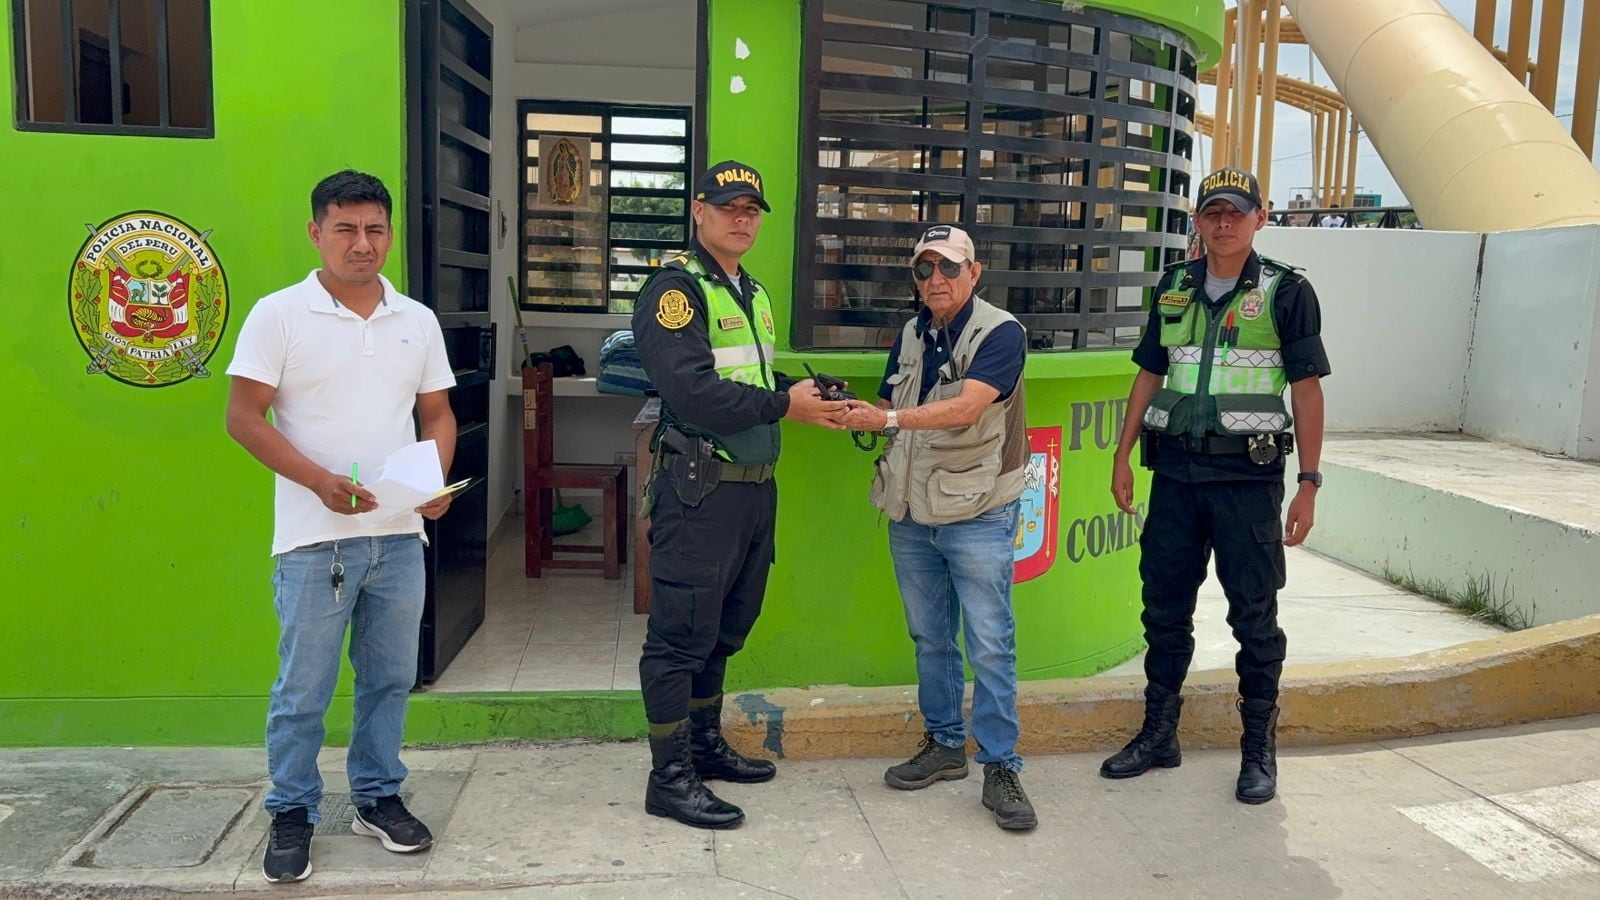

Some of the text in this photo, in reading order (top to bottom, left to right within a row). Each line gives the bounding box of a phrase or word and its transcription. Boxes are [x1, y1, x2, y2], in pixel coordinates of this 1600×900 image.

[716, 169, 760, 192] POLICIA
[1203, 170, 1250, 196] POLICIA
[87, 220, 207, 266] POLICIA NACIONAL
[119, 239, 178, 256] DEL PERU
[104, 332, 193, 359] DIOS PATRIA LEY
